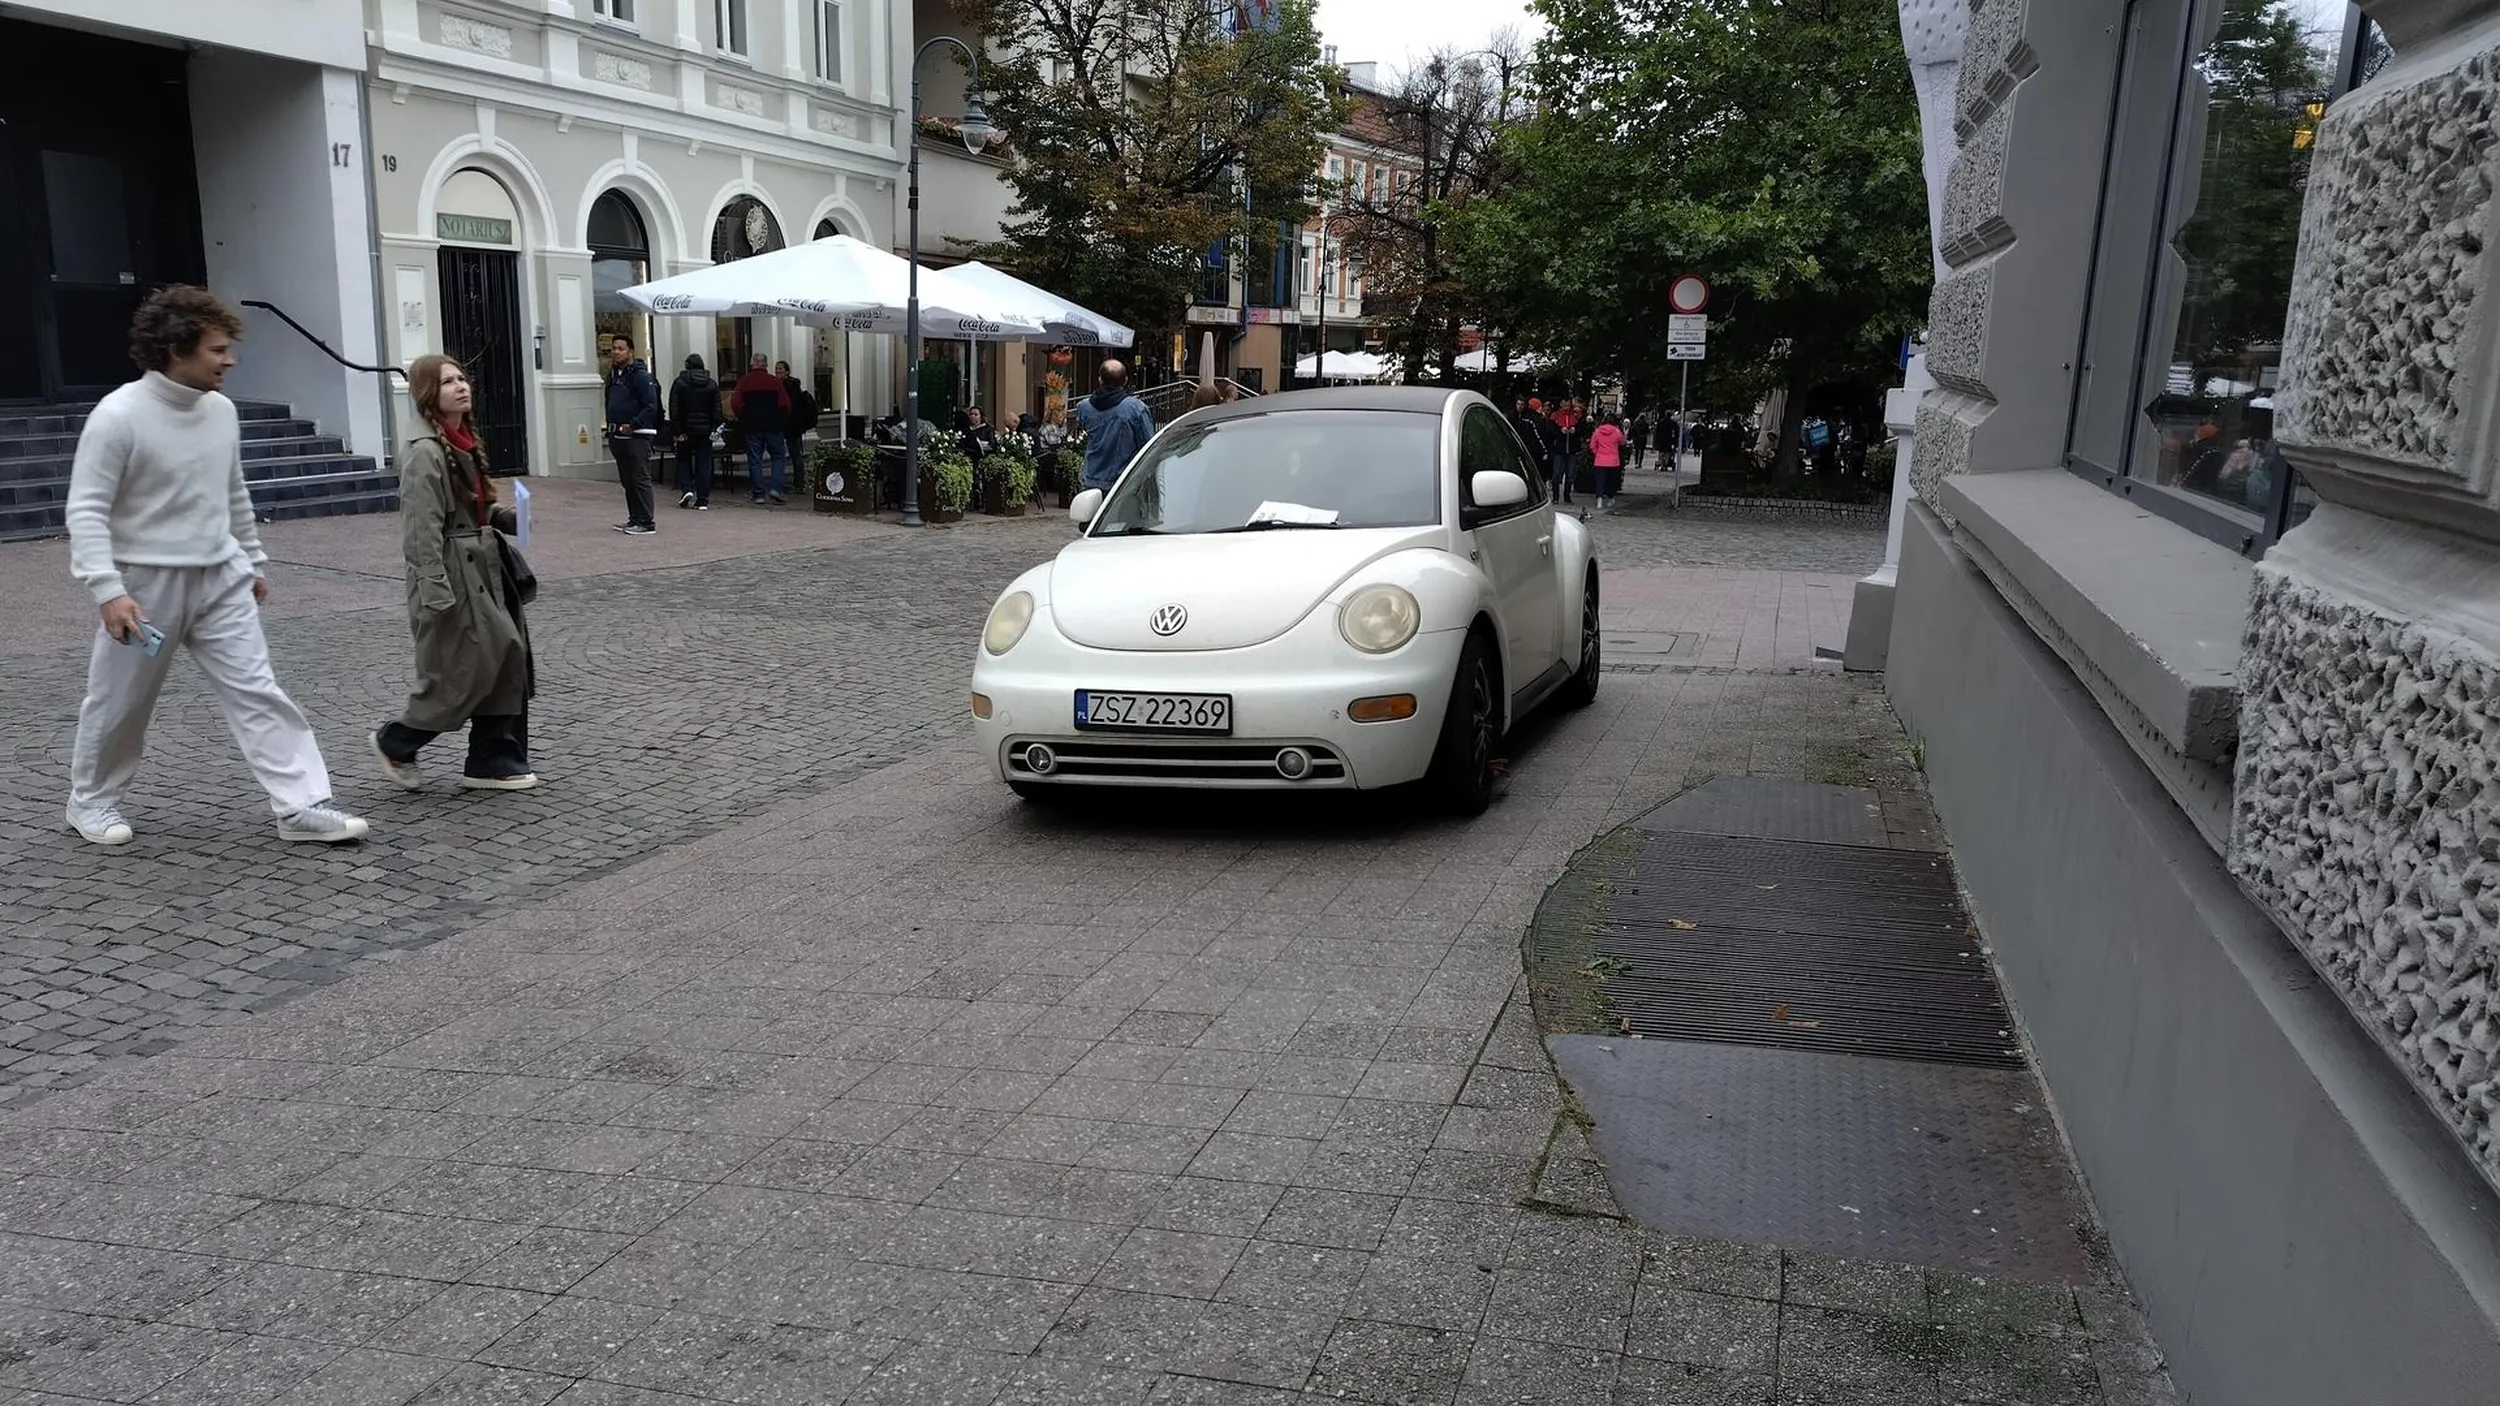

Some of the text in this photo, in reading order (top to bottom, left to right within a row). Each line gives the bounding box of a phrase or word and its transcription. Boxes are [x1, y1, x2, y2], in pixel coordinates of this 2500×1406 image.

[332, 143, 352, 167] 17
[382, 154, 397, 172] 19
[1077, 695, 1225, 727] PL ZSZ 22369
